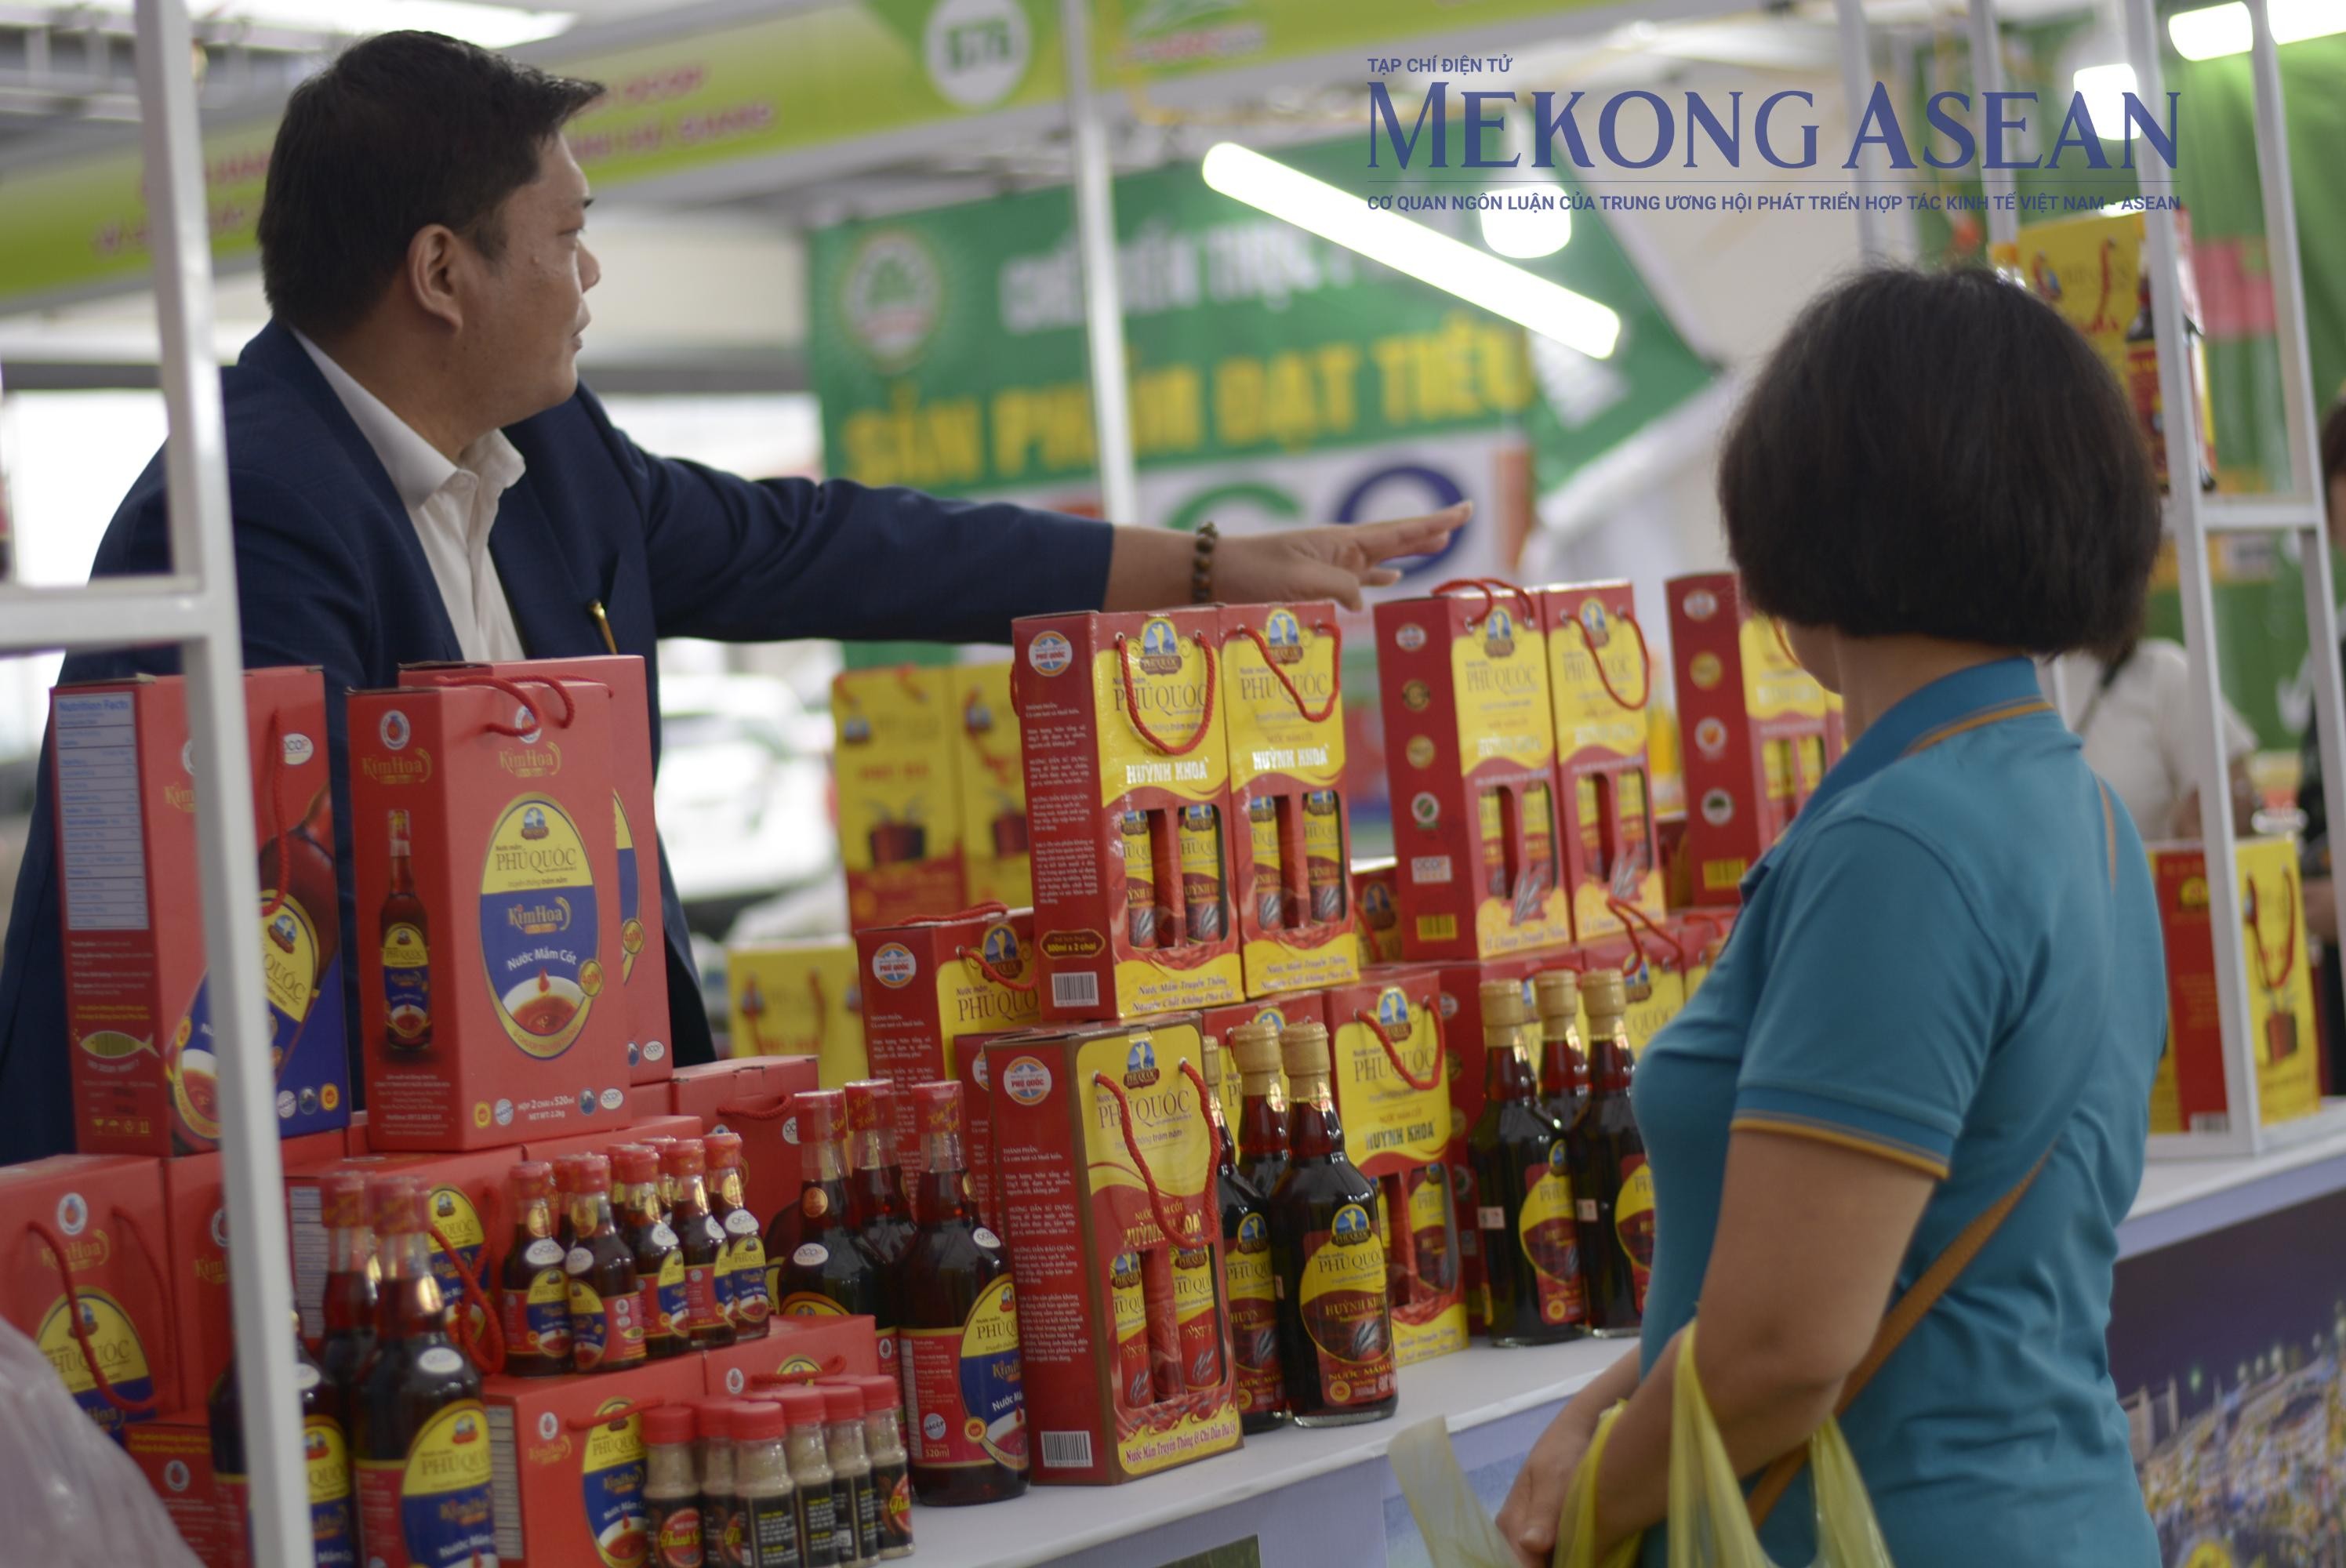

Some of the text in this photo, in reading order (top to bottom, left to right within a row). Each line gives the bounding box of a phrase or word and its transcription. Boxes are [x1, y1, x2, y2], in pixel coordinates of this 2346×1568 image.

[499, 748, 554, 772] KimHoa
[1252, 746, 1295, 770] HUỲNH
[1126, 759, 1172, 784] HUỲNH
[496, 844, 577, 873] PHÚ QUỐC
[507, 904, 564, 927] KimHoa
[507, 946, 578, 972] Nước Mắm Cốt
[957, 989, 994, 1022] PHÚ
[1011, 1078, 1045, 1088] PHÚ QUỐC
[1136, 1086, 1190, 1127] QUỐC
[1365, 1124, 1404, 1150] HUỲNH
[1325, 1298, 1365, 1317] HUỲNH
[991, 1395, 1014, 1412] Nước
[925, 1448, 950, 1458] 520ml
[1125, 1447, 1142, 1464] Nước
[1143, 1442, 1157, 1461] Mắm
[1157, 1436, 1176, 1457] Truyền
[1177, 1432, 1193, 1450] Thống
[1200, 1425, 1210, 1443] Chỉ
[1210, 1423, 1221, 1440] Dẫn
